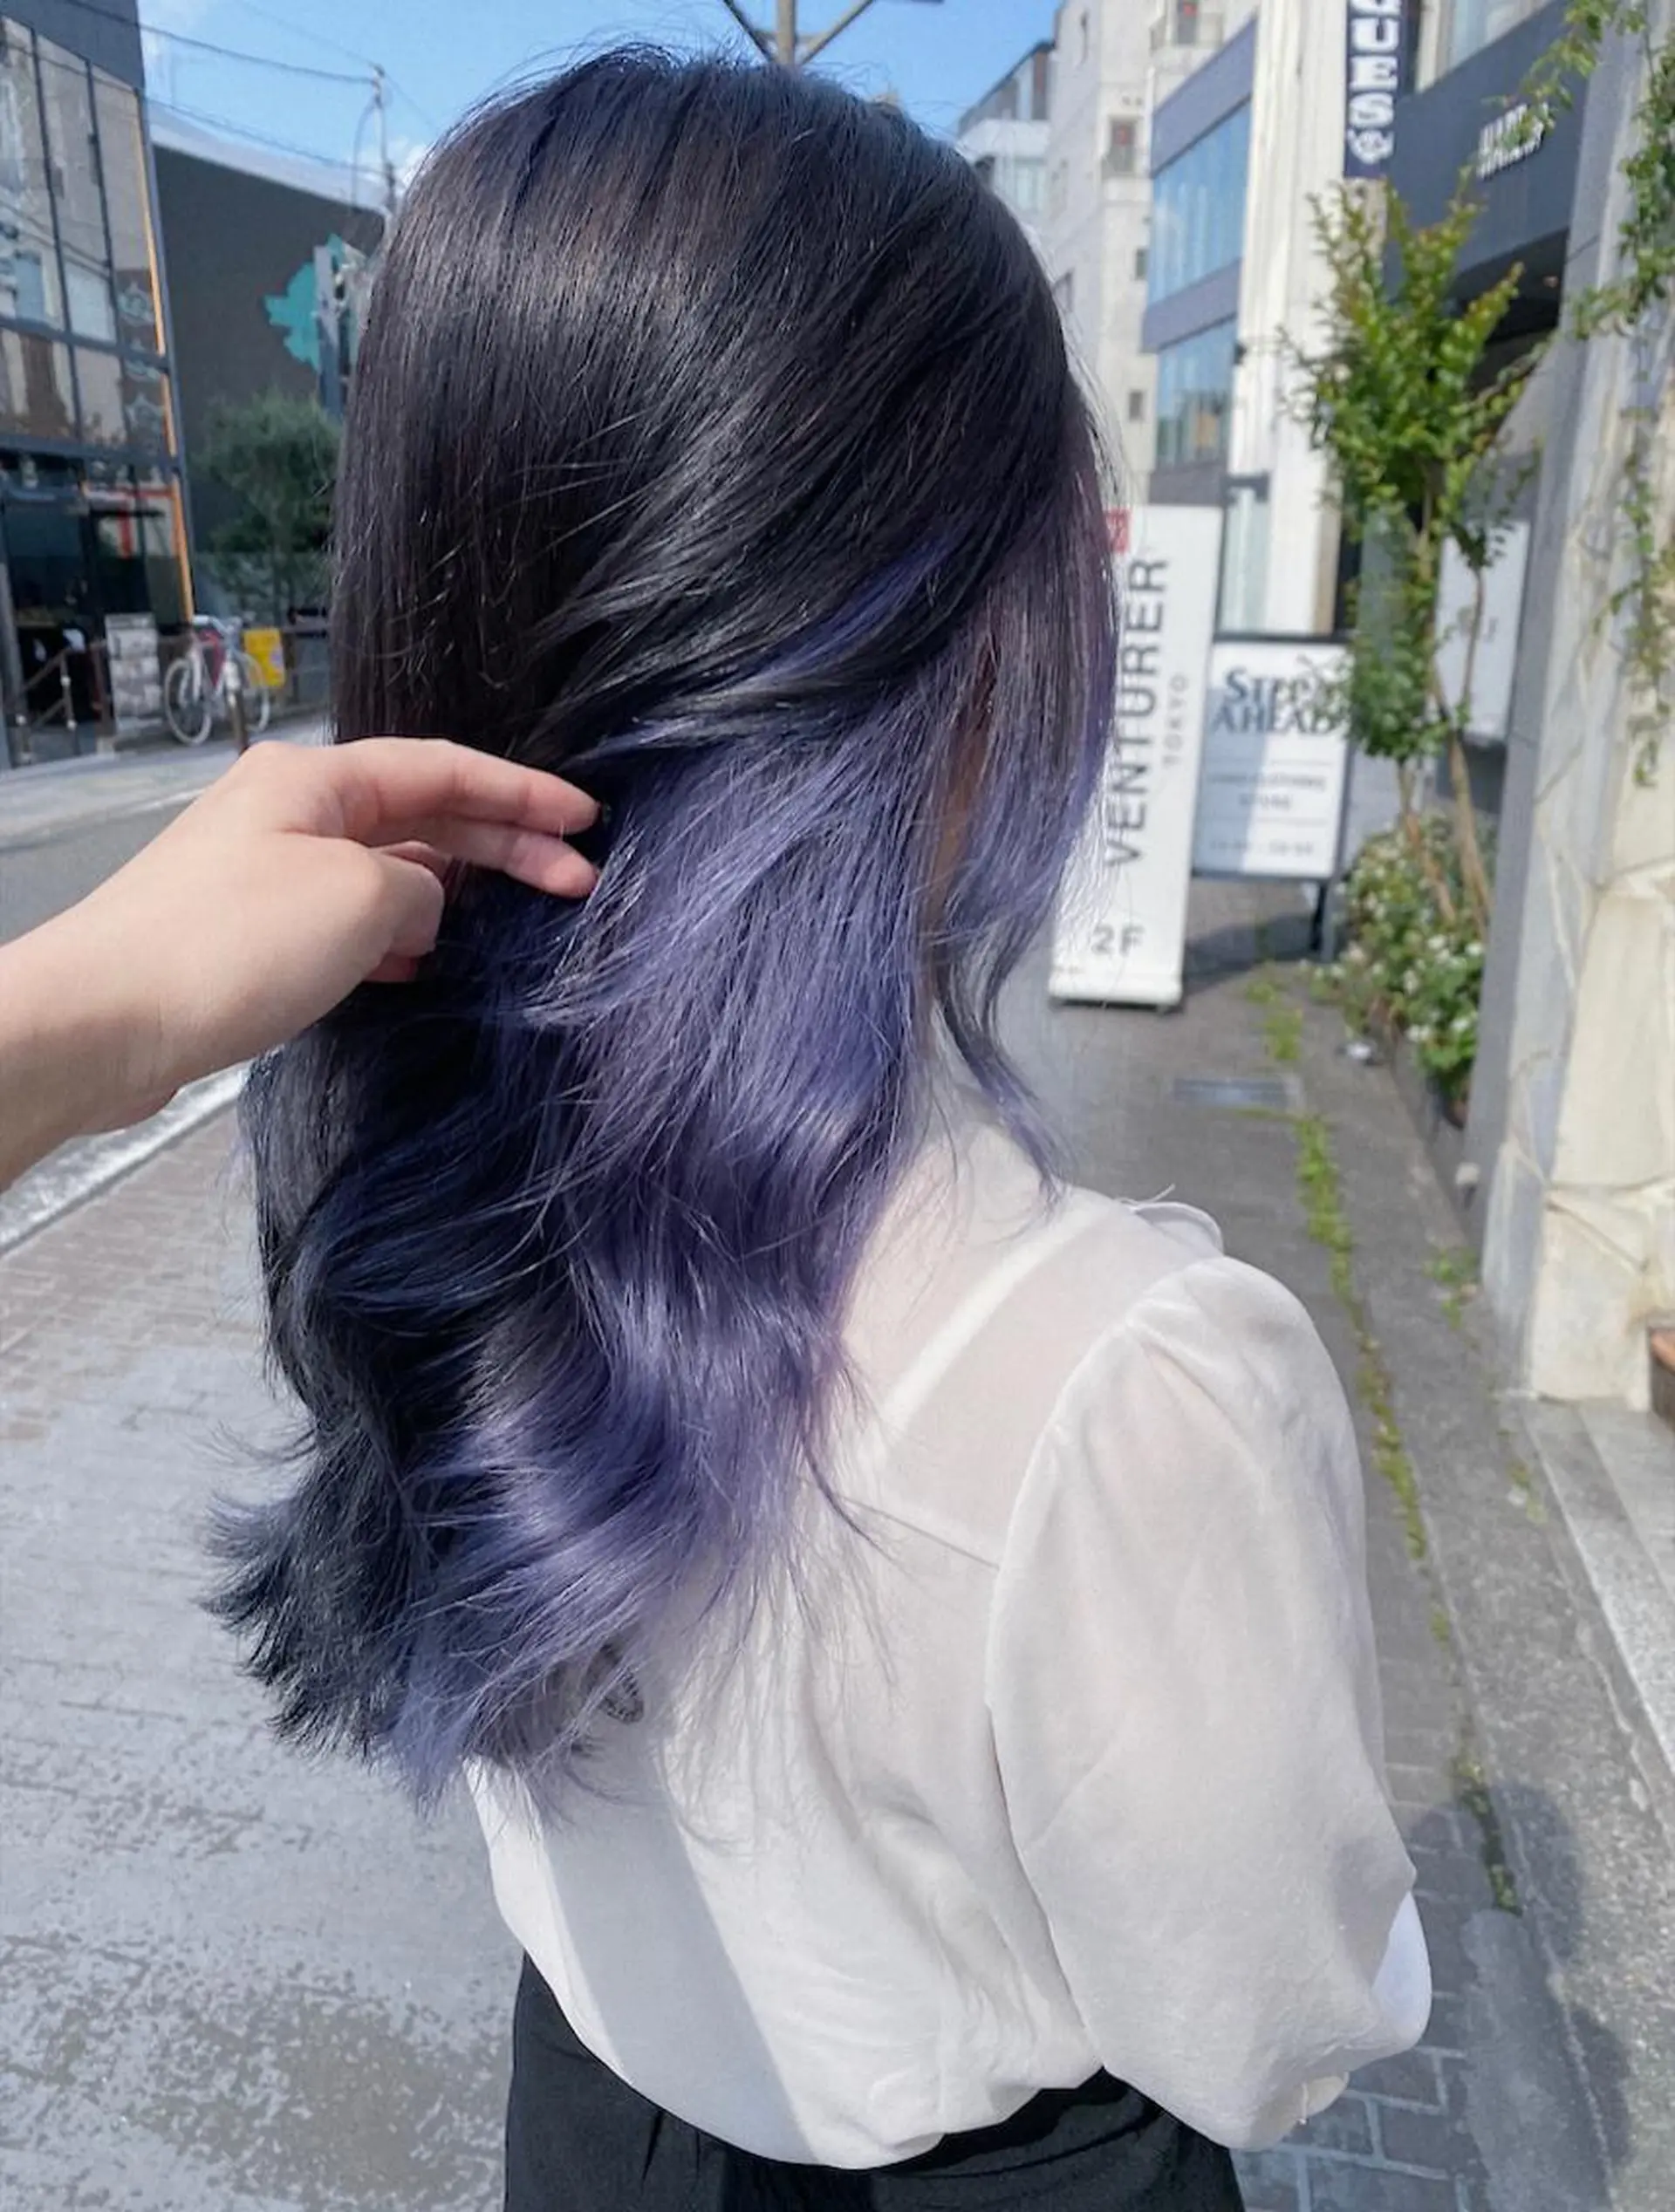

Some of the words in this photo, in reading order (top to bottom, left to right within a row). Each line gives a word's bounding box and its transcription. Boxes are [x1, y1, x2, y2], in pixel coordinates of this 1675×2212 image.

[1104, 558, 1169, 869] VENTURER
[1162, 674, 1189, 768] TOKYO
[1091, 925, 1145, 957] 2F
